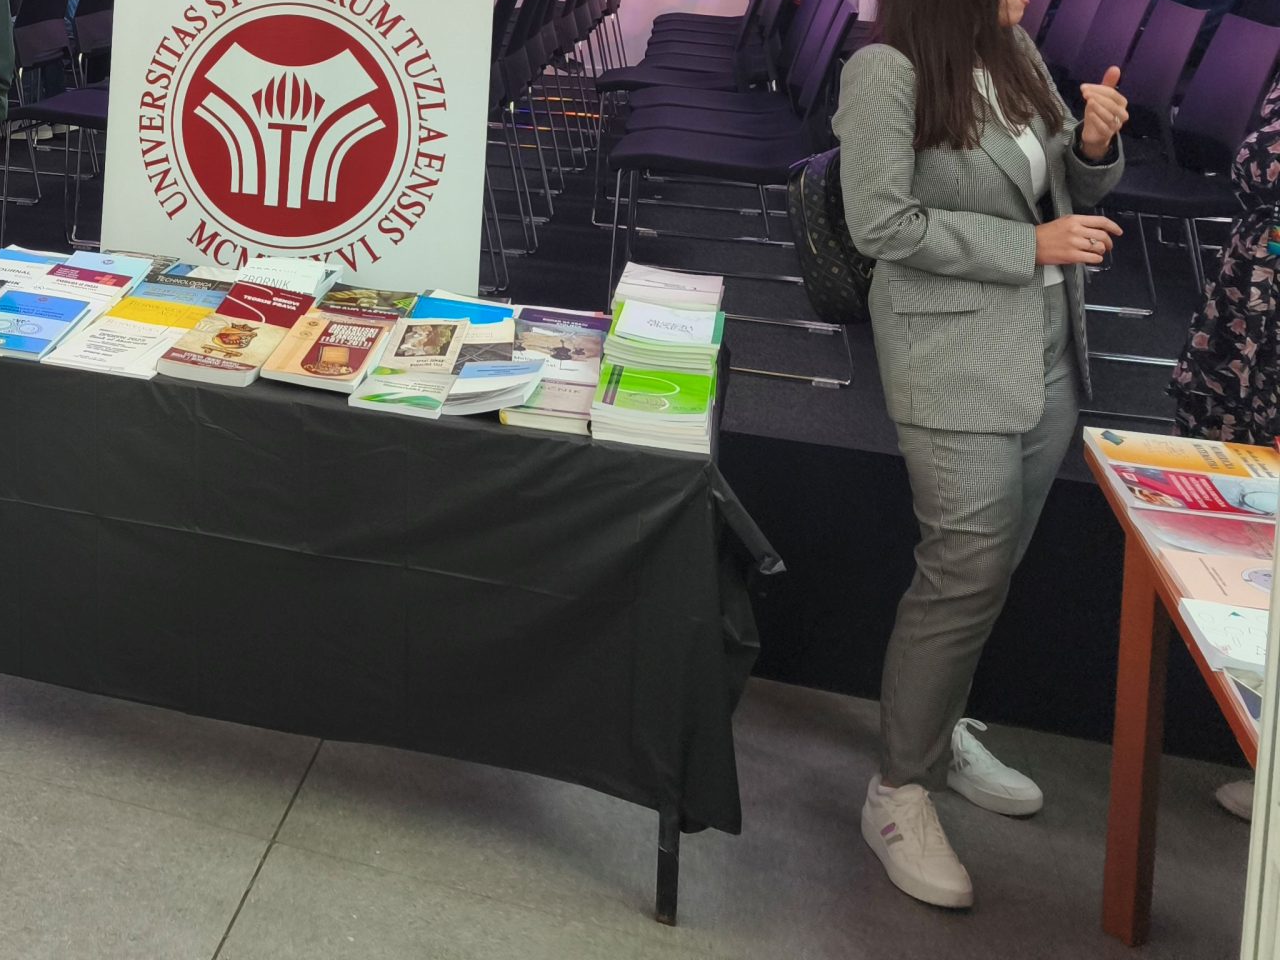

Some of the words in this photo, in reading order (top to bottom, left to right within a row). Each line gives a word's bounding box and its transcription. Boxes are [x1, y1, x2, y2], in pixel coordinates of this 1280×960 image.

[138, 5, 209, 221] UNIVERSITAS
[186, 218, 382, 273] MCVI
[157, 275, 212, 288] TECHNOLOGICA
[242, 273, 292, 290] ZBORNIK
[243, 294, 272, 305] TEORIJE
[272, 301, 297, 311] PRAVA
[272, 297, 300, 307] OSNOVI
